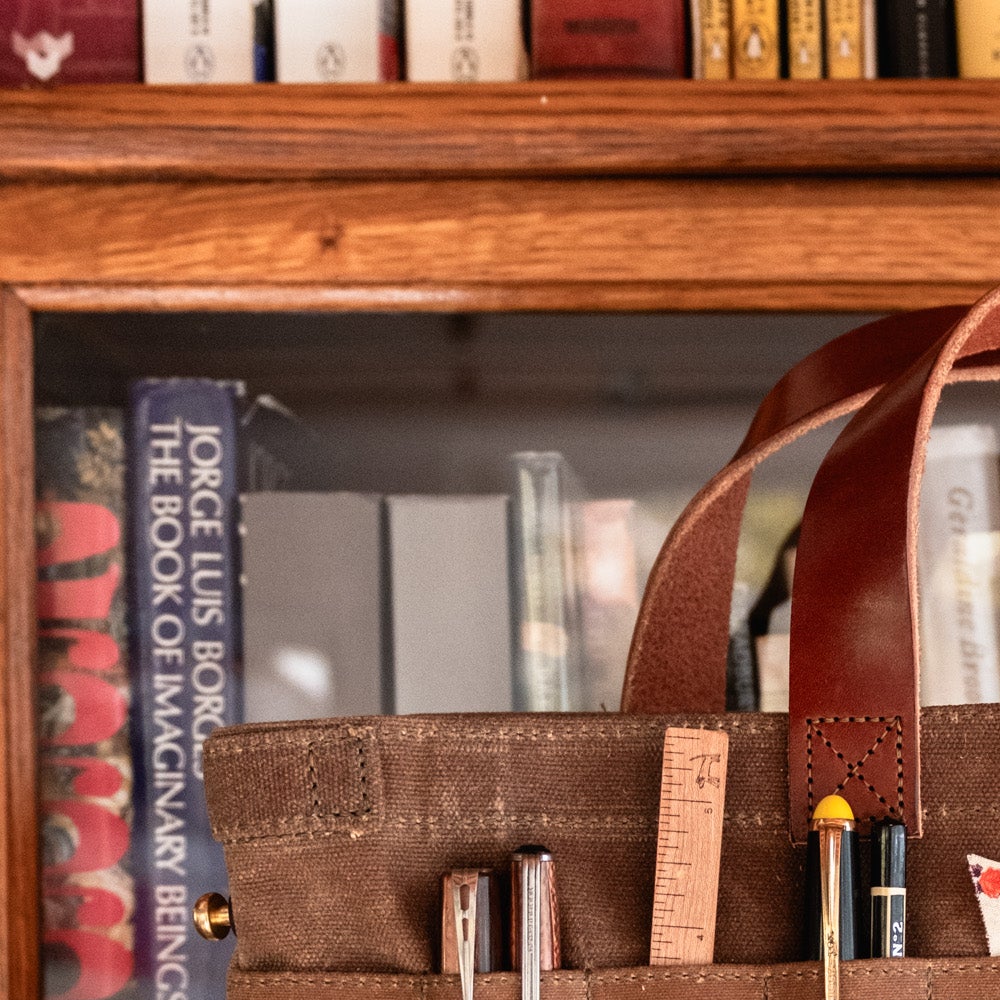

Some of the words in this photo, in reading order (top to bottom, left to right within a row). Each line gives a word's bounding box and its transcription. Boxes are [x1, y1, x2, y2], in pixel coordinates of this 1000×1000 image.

[150, 418, 184, 486] THE
[184, 422, 223, 537] JORGE
[151, 495, 185, 605] BOOK
[191, 552, 224, 627] LUIS
[152, 613, 186, 666] OF
[191, 641, 226, 780] BORG
[153, 674, 188, 877] IMAGINARY
